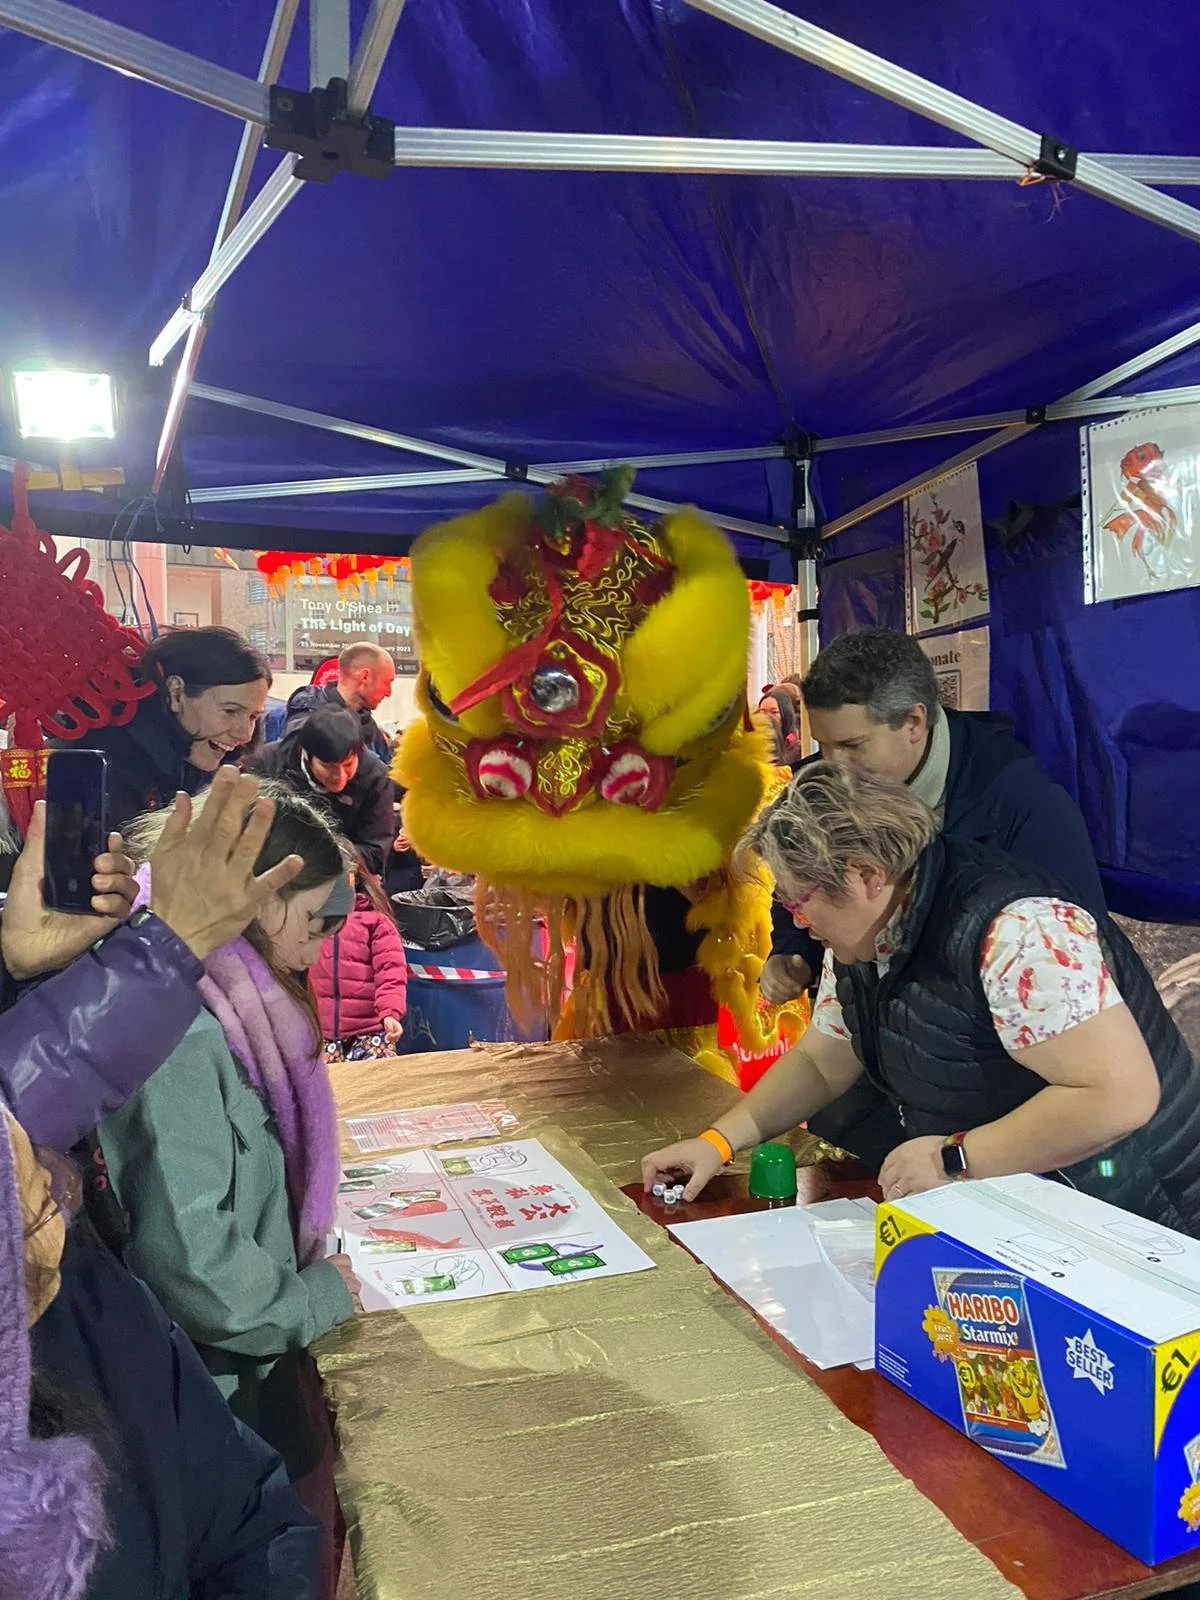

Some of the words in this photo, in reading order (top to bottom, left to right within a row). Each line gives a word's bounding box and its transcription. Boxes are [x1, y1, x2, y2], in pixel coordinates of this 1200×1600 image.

[300, 598, 332, 613] Tony
[300, 618, 327, 630] The
[330, 619, 367, 633] Light
[369, 621, 383, 633] of
[385, 622, 411, 637] Day
[9, 758, 32, 779] 福
[879, 1214, 902, 1247] €1
[947, 1294, 1020, 1326] HARIBO
[961, 1323, 1018, 1347] Starmix
[1074, 1339, 1106, 1367] BEST
[1068, 1350, 1112, 1388] SELLER
[1160, 1348, 1192, 1394] €1
